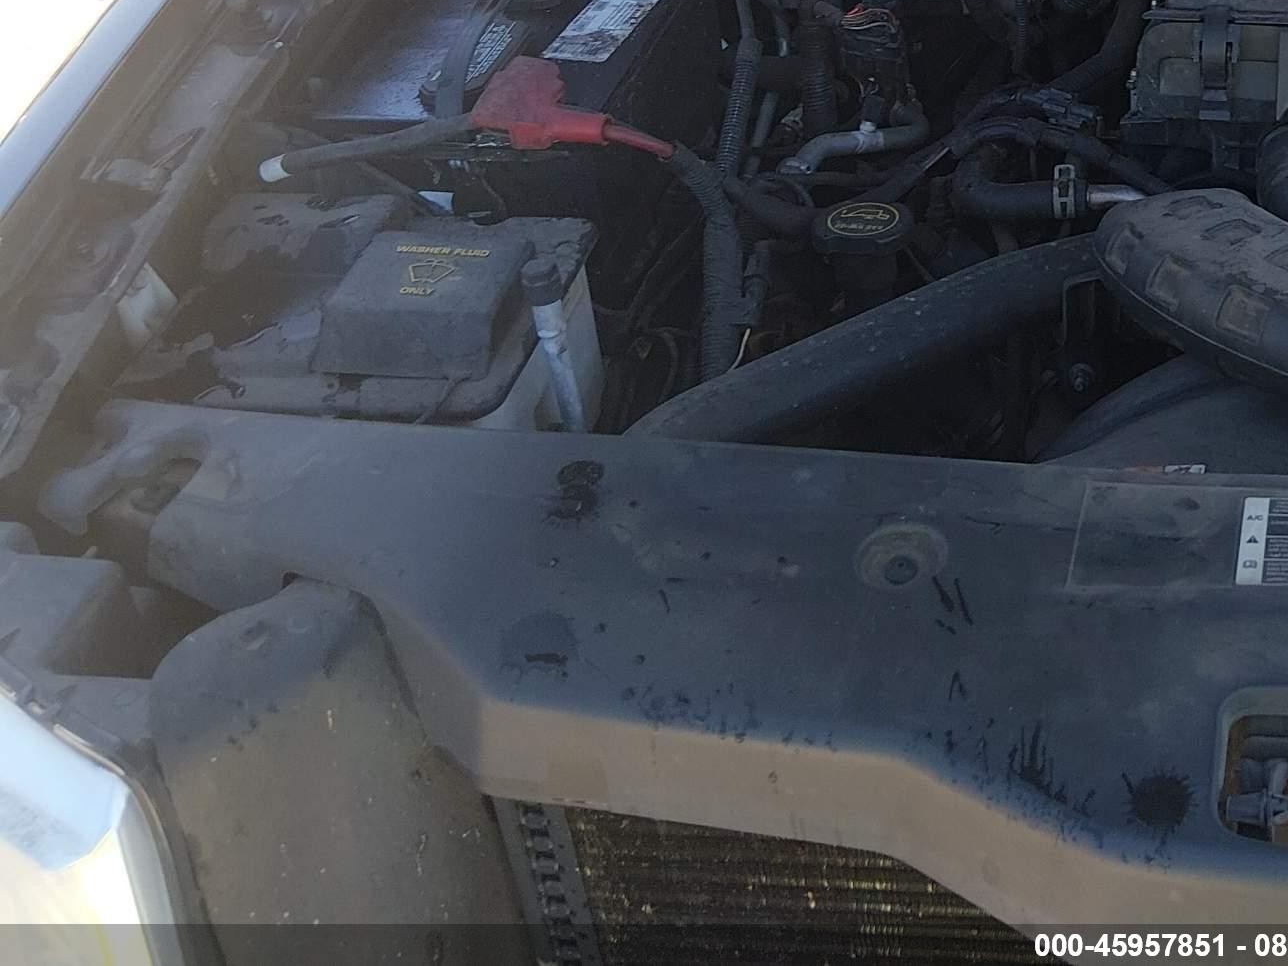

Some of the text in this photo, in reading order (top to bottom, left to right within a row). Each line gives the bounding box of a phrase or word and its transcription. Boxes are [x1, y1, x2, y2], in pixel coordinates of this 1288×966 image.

[396, 244, 491, 257] WASHER FLUID
[399, 285, 435, 296] ONLY
